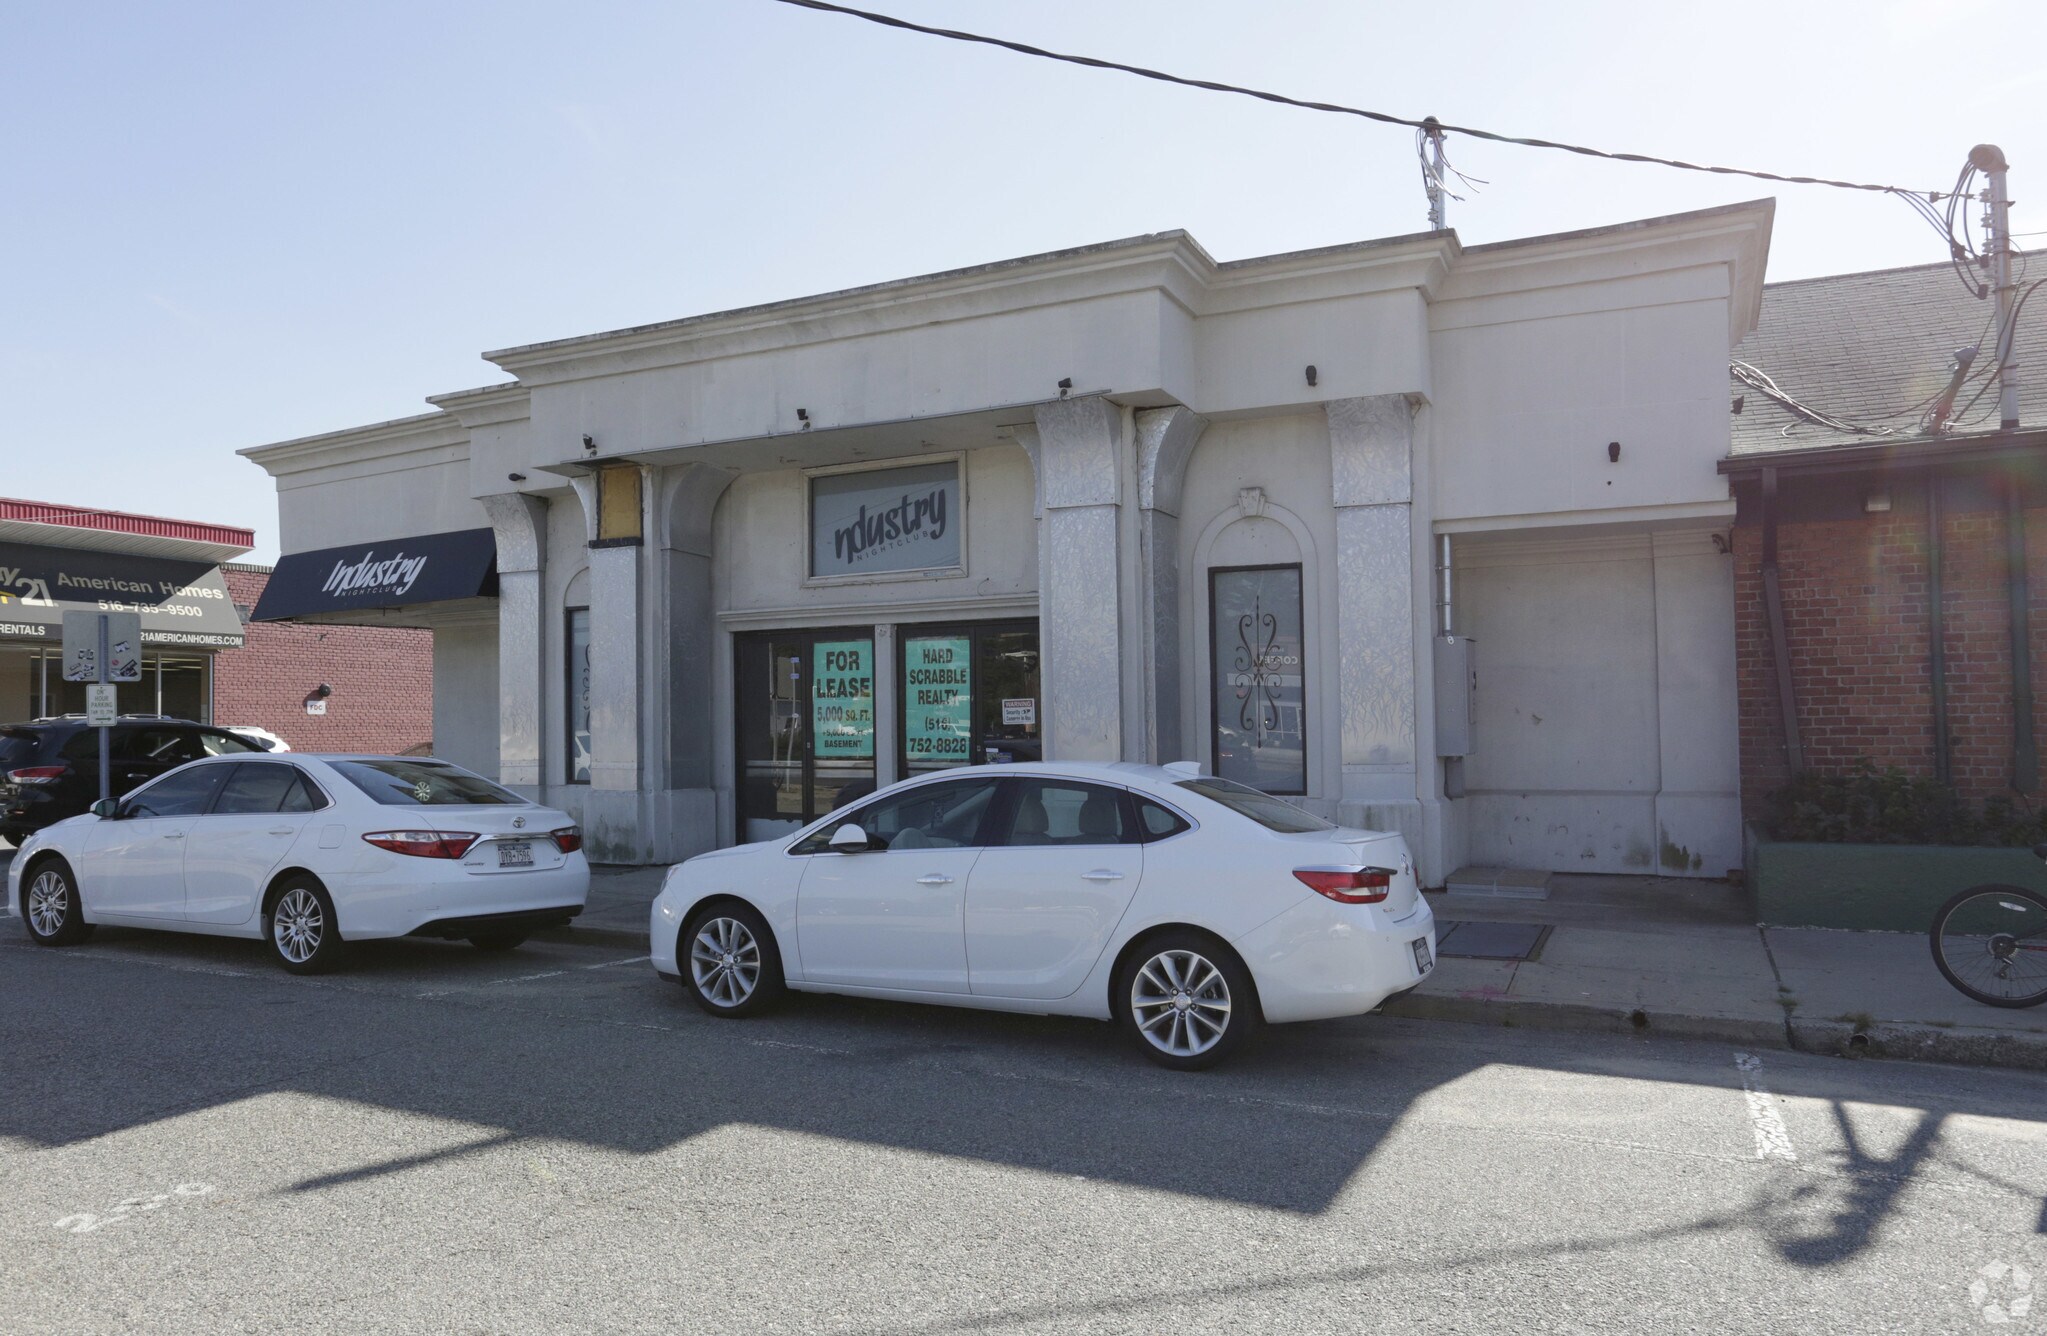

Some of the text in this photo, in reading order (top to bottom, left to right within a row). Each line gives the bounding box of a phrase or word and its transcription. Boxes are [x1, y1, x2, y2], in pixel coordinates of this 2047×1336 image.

[856, 530, 929, 562] NIGHTCLUB
[321, 550, 428, 597] Industry
[15, 577, 54, 608] 21
[57, 571, 224, 600] American Homes
[341, 585, 398, 597] NIGHTCLUB
[97, 599, 203, 617] 516-735-9500
[0, 623, 45, 636] RENTALS
[826, 650, 860, 672] FOR
[922, 648, 953, 664] HARD
[909, 668, 967, 685] SCRABBLE
[816, 677, 871, 698] LEASE
[917, 689, 959, 705] REALTY
[817, 705, 843, 724] 5,000
[845, 709, 858, 722] SQ.
[824, 739, 863, 748] BASEMENT
[909, 737, 967, 754] 752-8828
